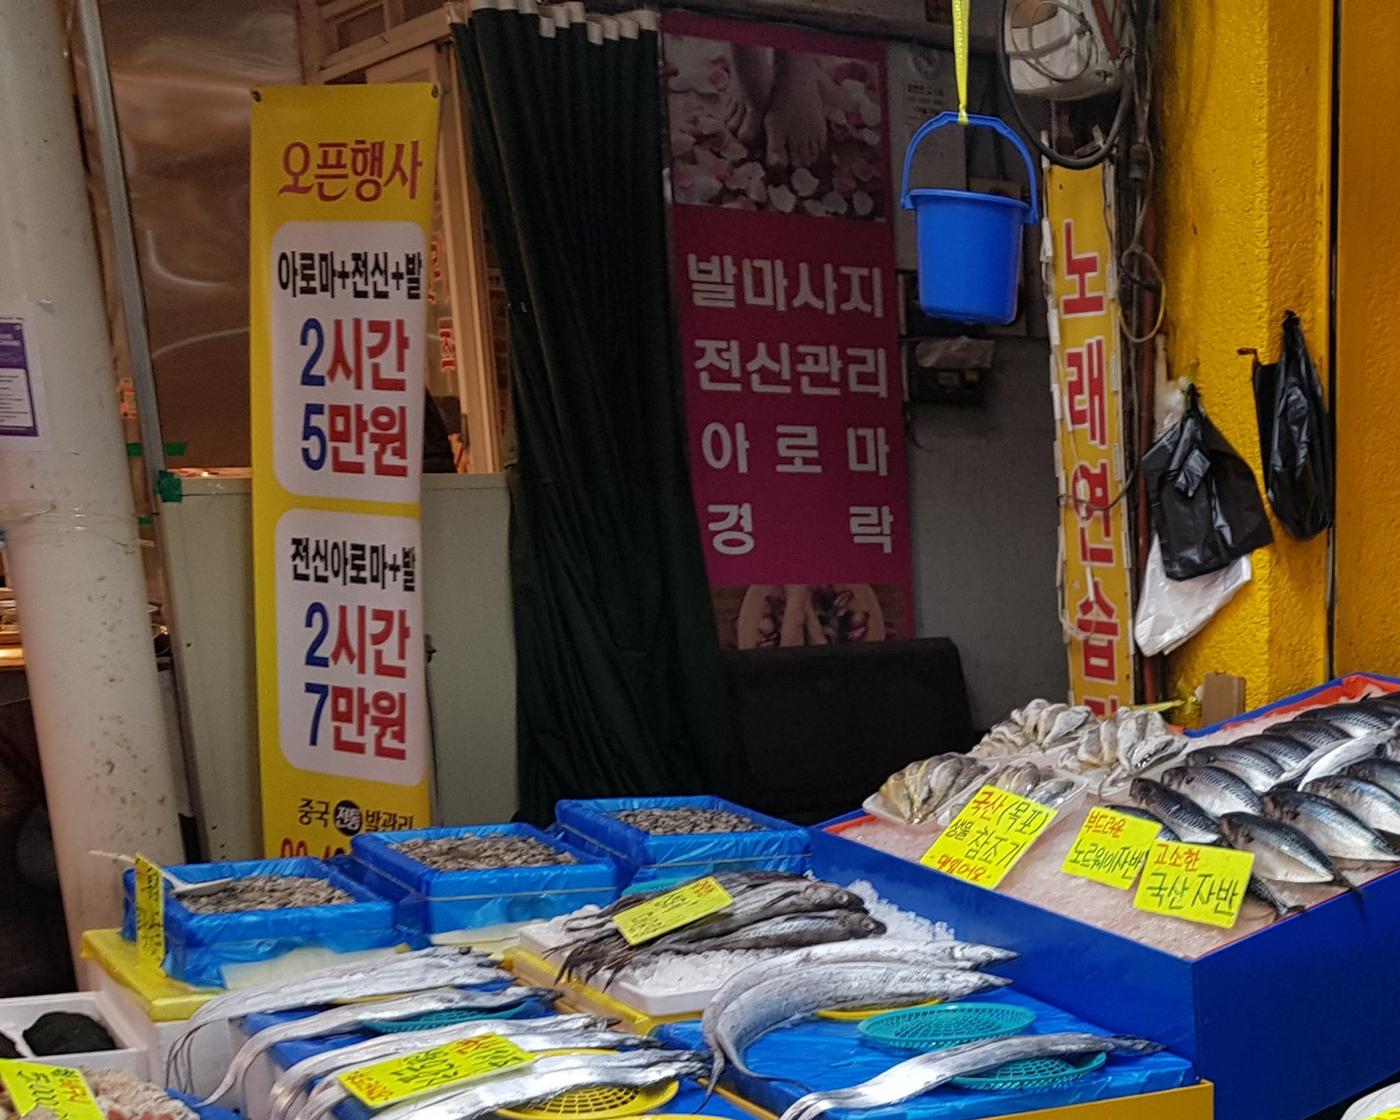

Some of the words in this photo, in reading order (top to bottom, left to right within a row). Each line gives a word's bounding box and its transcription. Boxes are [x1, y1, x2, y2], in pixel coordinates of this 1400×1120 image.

[277, 139, 423, 203] 오픈행사
[277, 250, 423, 300] 아로마+전신+발
[686, 252, 885, 319] 발마사지
[299, 317, 411, 392] 2시간
[693, 338, 889, 398] 전신관리
[300, 402, 409, 478] 5만원
[290, 537, 416, 593] 전신아로마+발
[303, 601, 411, 679] 2시간
[303, 682, 407, 761] 7만원
[298, 798, 330, 828] 중국
[970, 790, 1009, 821] 국산
[996, 800, 1049, 836] (목포)
[944, 818, 974, 841] 생물
[964, 826, 1028, 869] 참조기
[1153, 843, 1201, 873] 고소한
[1146, 872, 1190, 910] 국산
[1191, 873, 1239, 917] 자반
